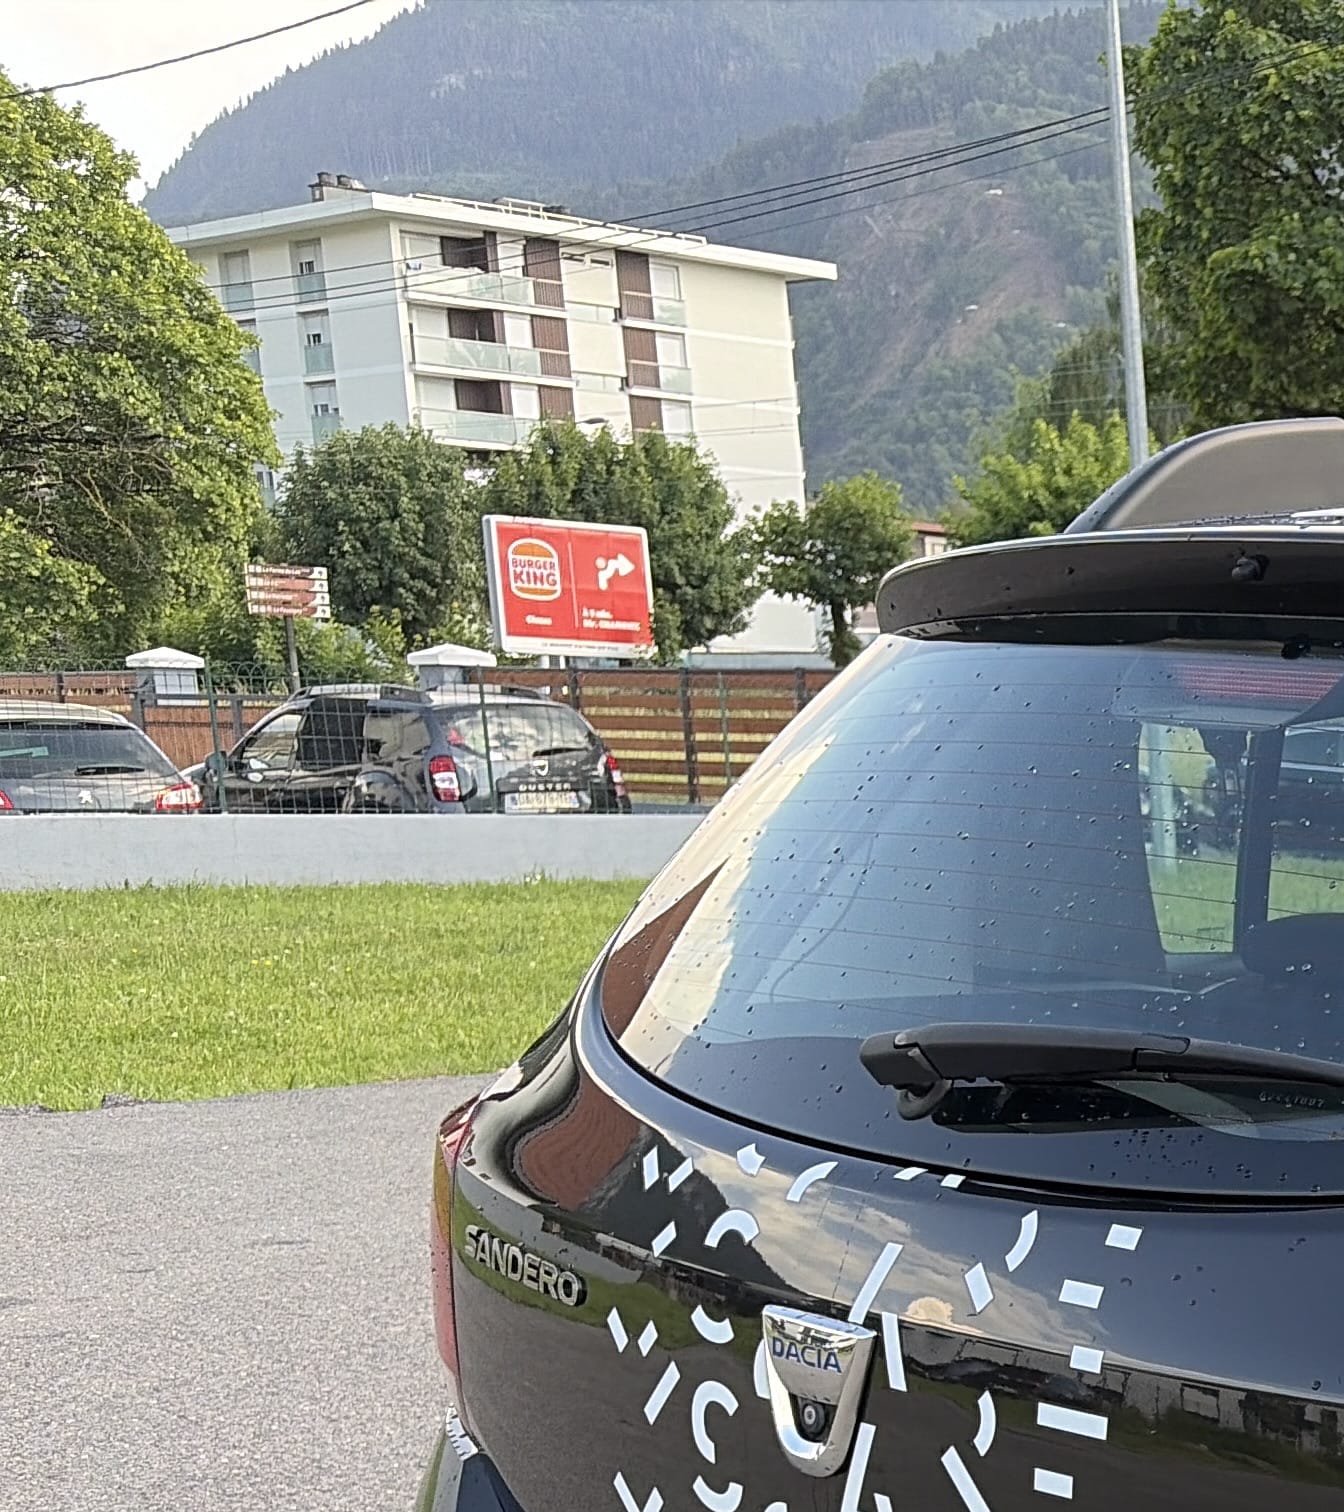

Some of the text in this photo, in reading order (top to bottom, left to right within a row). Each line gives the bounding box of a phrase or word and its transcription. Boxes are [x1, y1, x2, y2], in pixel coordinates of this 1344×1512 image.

[511, 557, 556, 570] BURGER
[513, 569, 558, 587] KING
[519, 783, 571, 791] DUSTER
[464, 1224, 583, 1306] SANDERO
[772, 1336, 843, 1374] DACIA
